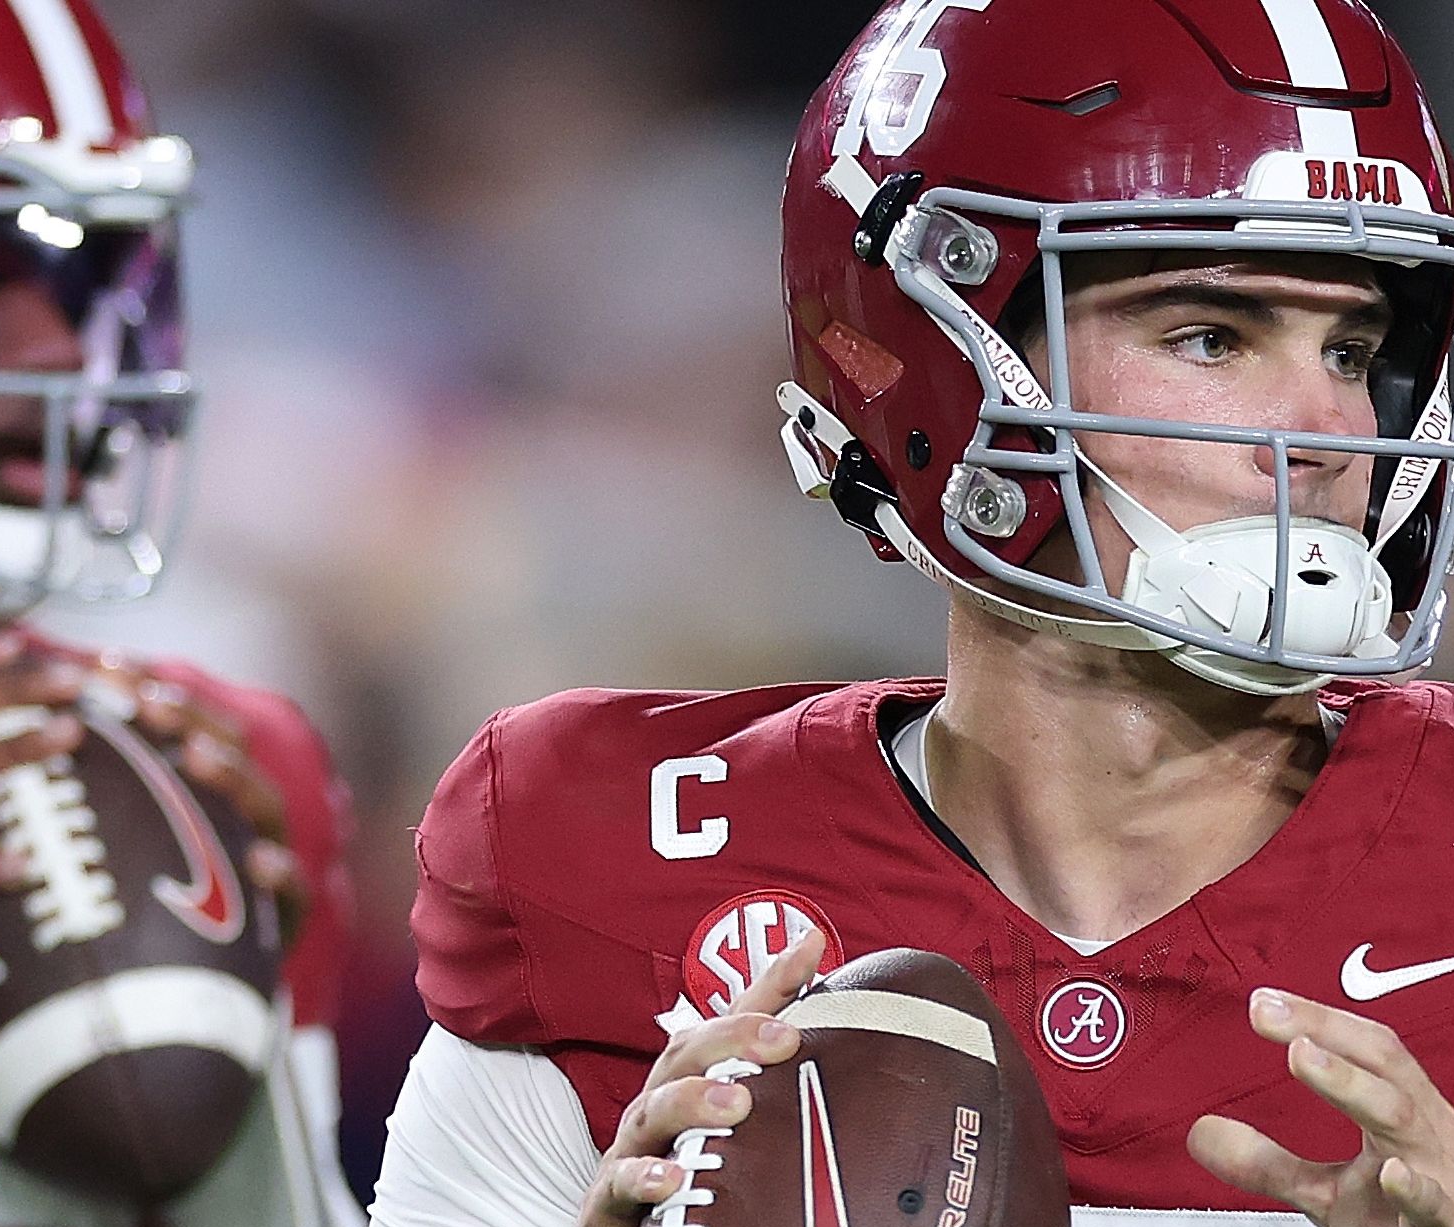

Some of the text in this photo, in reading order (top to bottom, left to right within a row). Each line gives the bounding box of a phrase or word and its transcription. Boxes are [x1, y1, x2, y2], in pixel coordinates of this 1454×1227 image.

[831, 0, 993, 156] 15
[1305, 160, 1403, 205] BAMA
[1391, 404, 1448, 500] CRIMON
[1300, 543, 1326, 564] A
[650, 754, 729, 861] C
[1054, 993, 1106, 1044] A
[946, 1106, 980, 1209] ELITE
